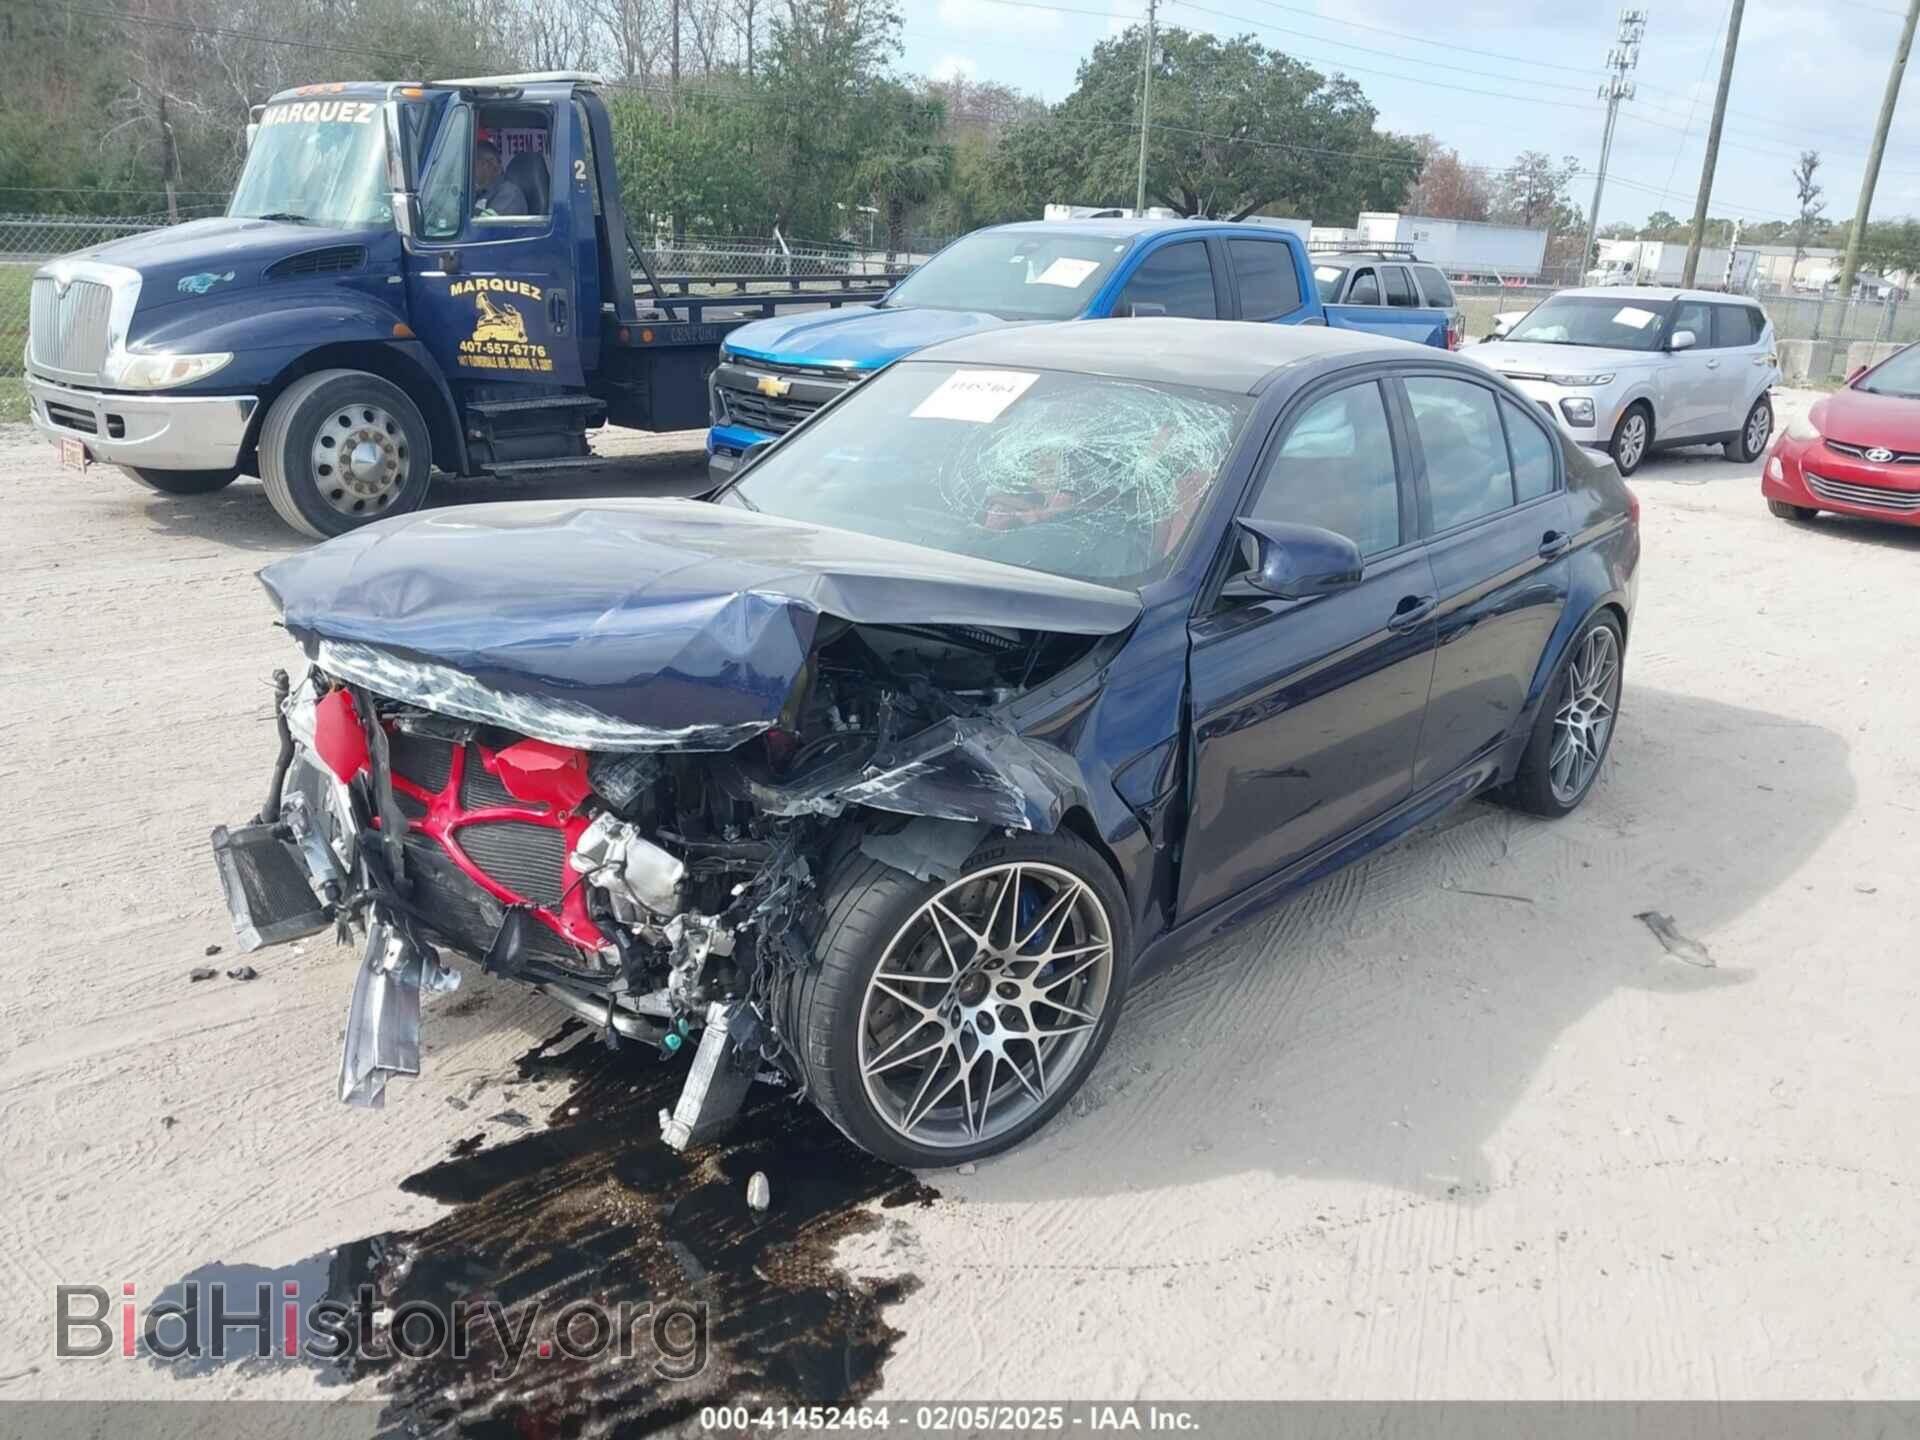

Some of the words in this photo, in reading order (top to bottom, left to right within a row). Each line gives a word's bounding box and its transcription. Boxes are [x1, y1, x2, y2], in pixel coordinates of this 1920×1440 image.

[261, 102, 377, 126] MARQUEZ
[574, 160, 587, 180] 2
[450, 278, 542, 301] MARQUEZ
[459, 340, 546, 357] 407-557-6776
